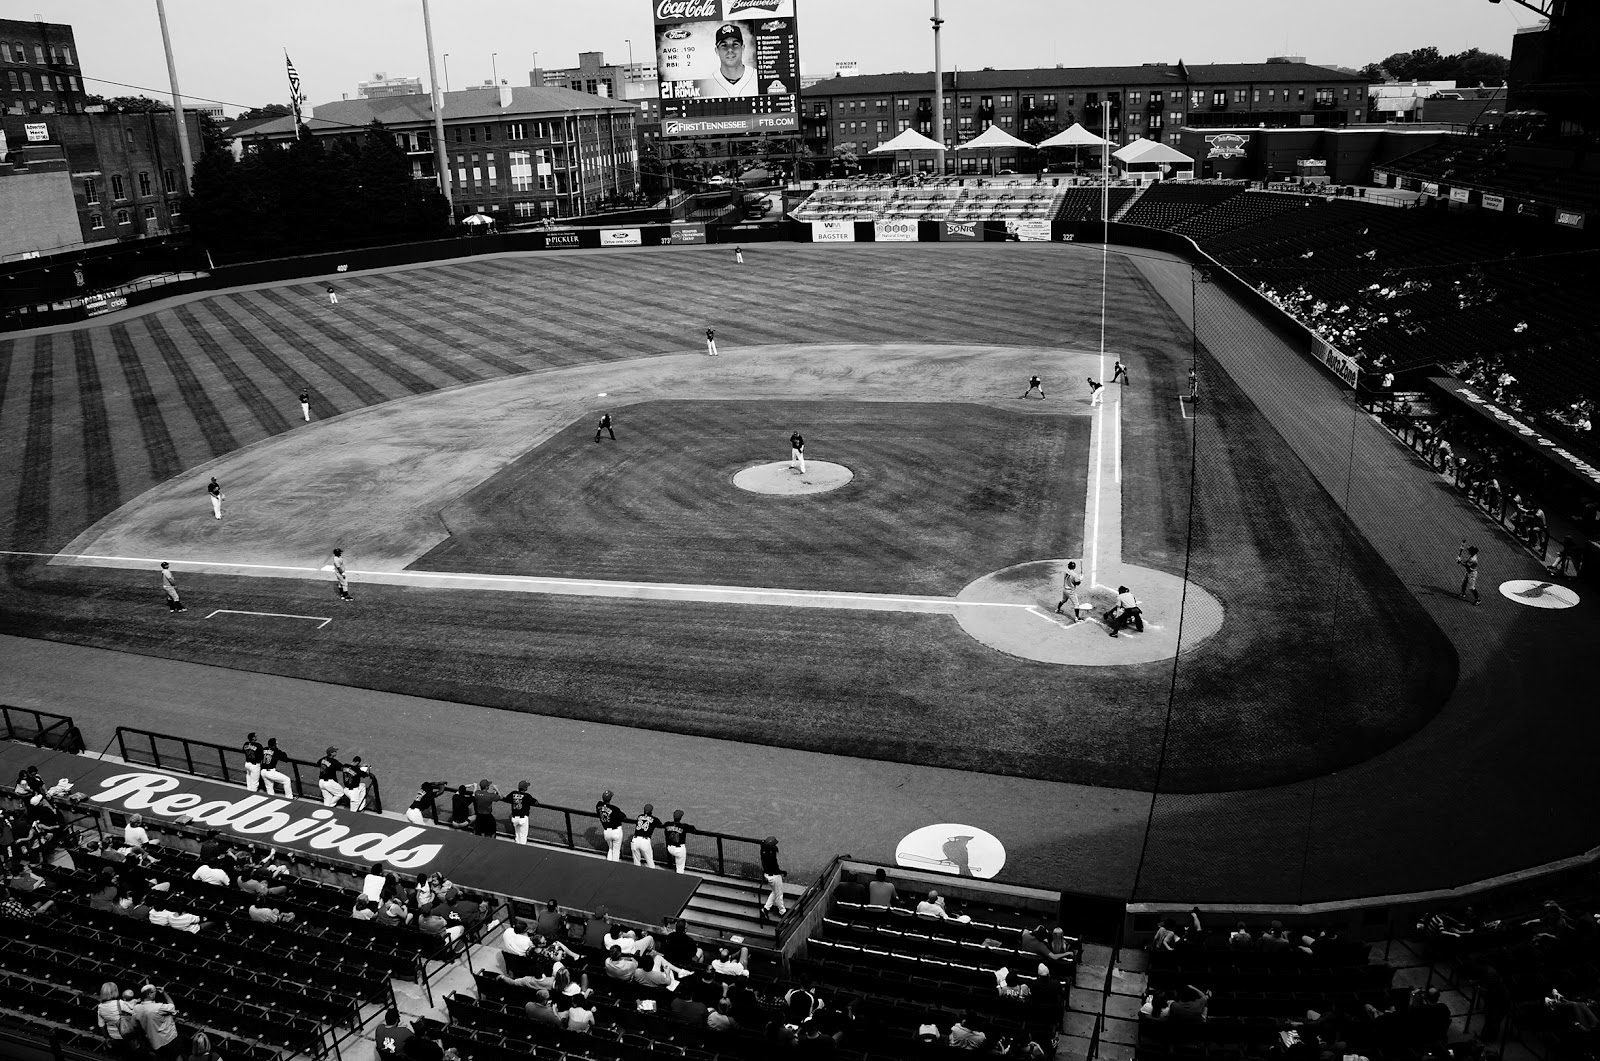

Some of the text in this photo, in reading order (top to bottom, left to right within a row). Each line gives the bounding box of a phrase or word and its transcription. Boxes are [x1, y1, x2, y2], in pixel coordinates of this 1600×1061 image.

[657, 0, 716, 19] Coca-Cola
[661, 81, 673, 99] 21
[675, 87, 700, 98] ROMAK
[678, 122, 700, 131] FIRST
[759, 117, 794, 126] FTB.COM
[948, 225, 974, 233] SONIC
[552, 235, 579, 243] PICKLER
[1325, 349, 1357, 388] AutoZone
[91, 772, 443, 868] Redbirds
